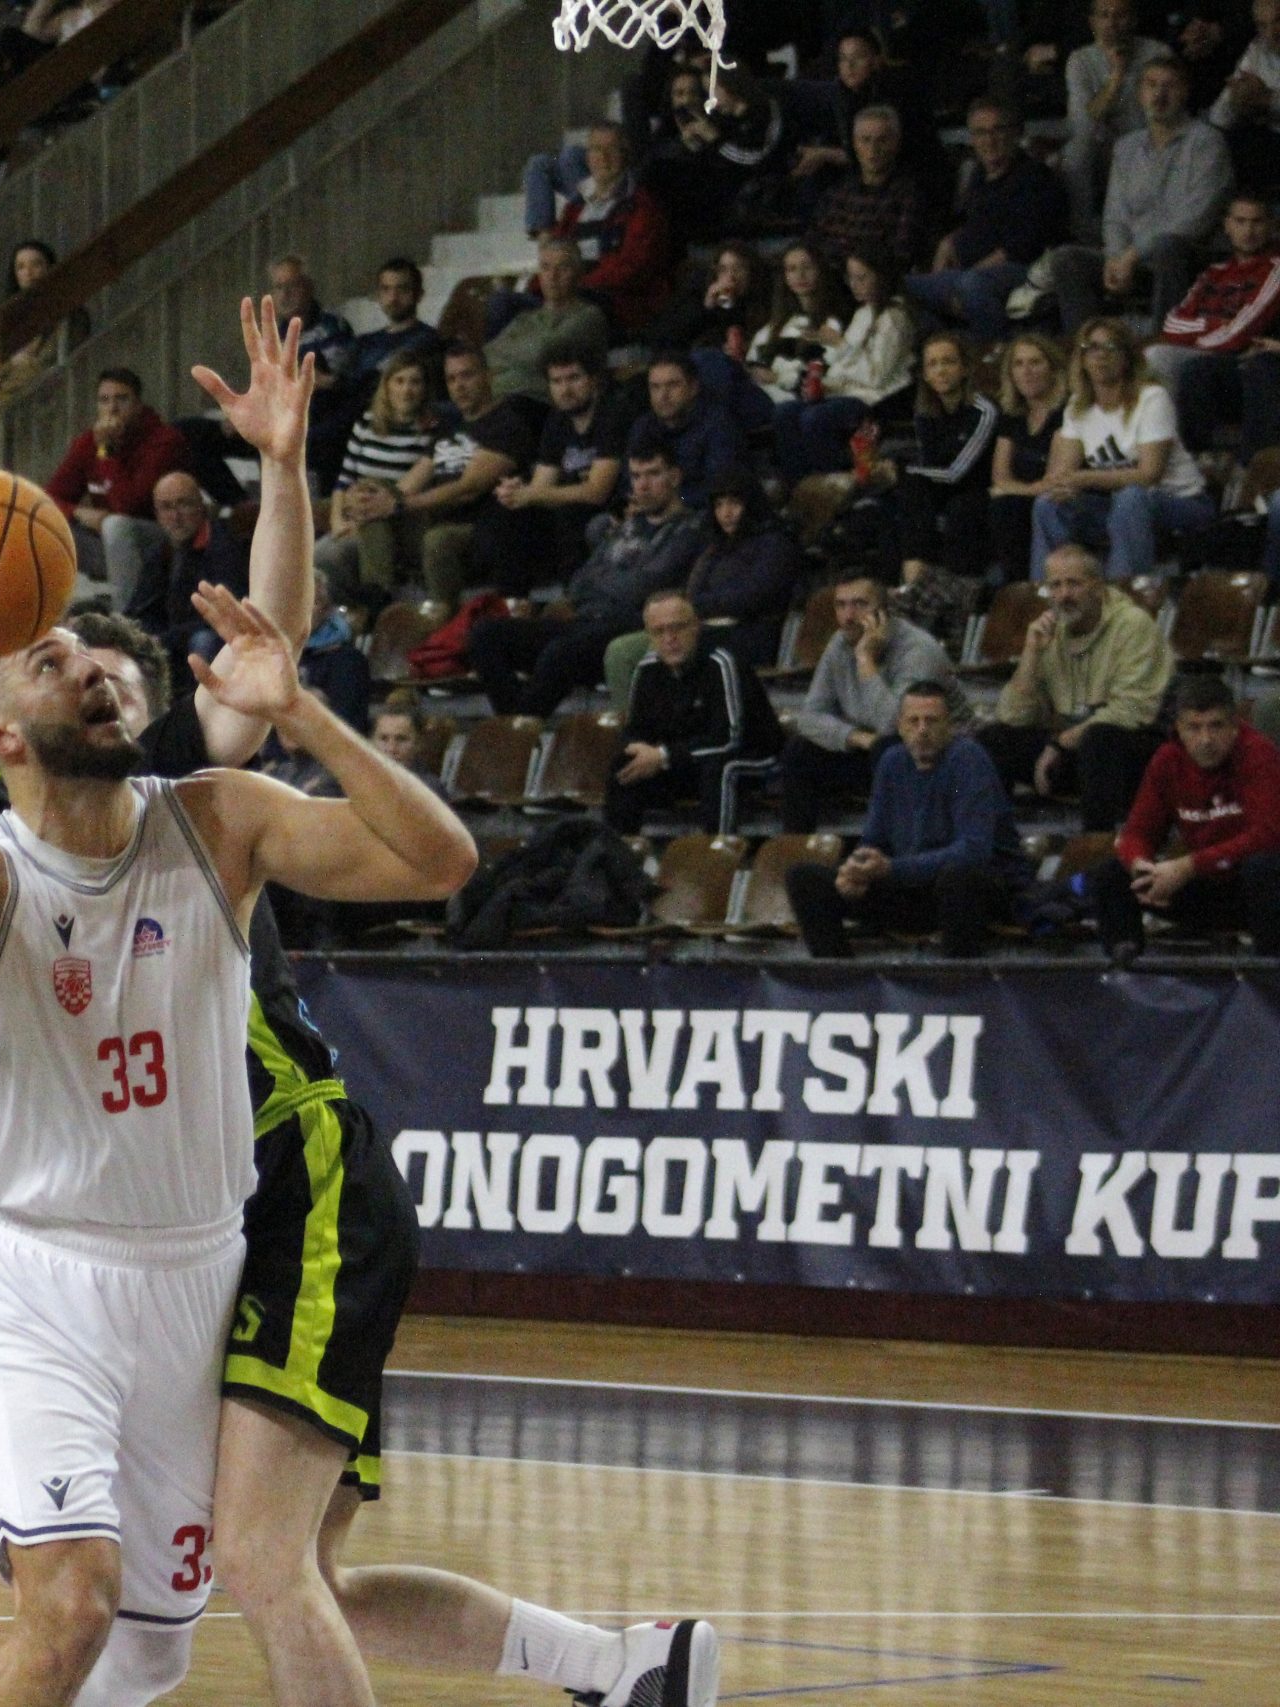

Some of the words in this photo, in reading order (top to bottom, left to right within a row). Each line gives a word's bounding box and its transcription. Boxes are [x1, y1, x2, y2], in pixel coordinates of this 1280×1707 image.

[98, 1030, 167, 1113] 33
[483, 1007, 982, 1119] HRVATSKI
[391, 1129, 1040, 1254] ONOGOMETNI
[1065, 1151, 1280, 1259] KUP
[171, 1524, 215, 1592] 3
